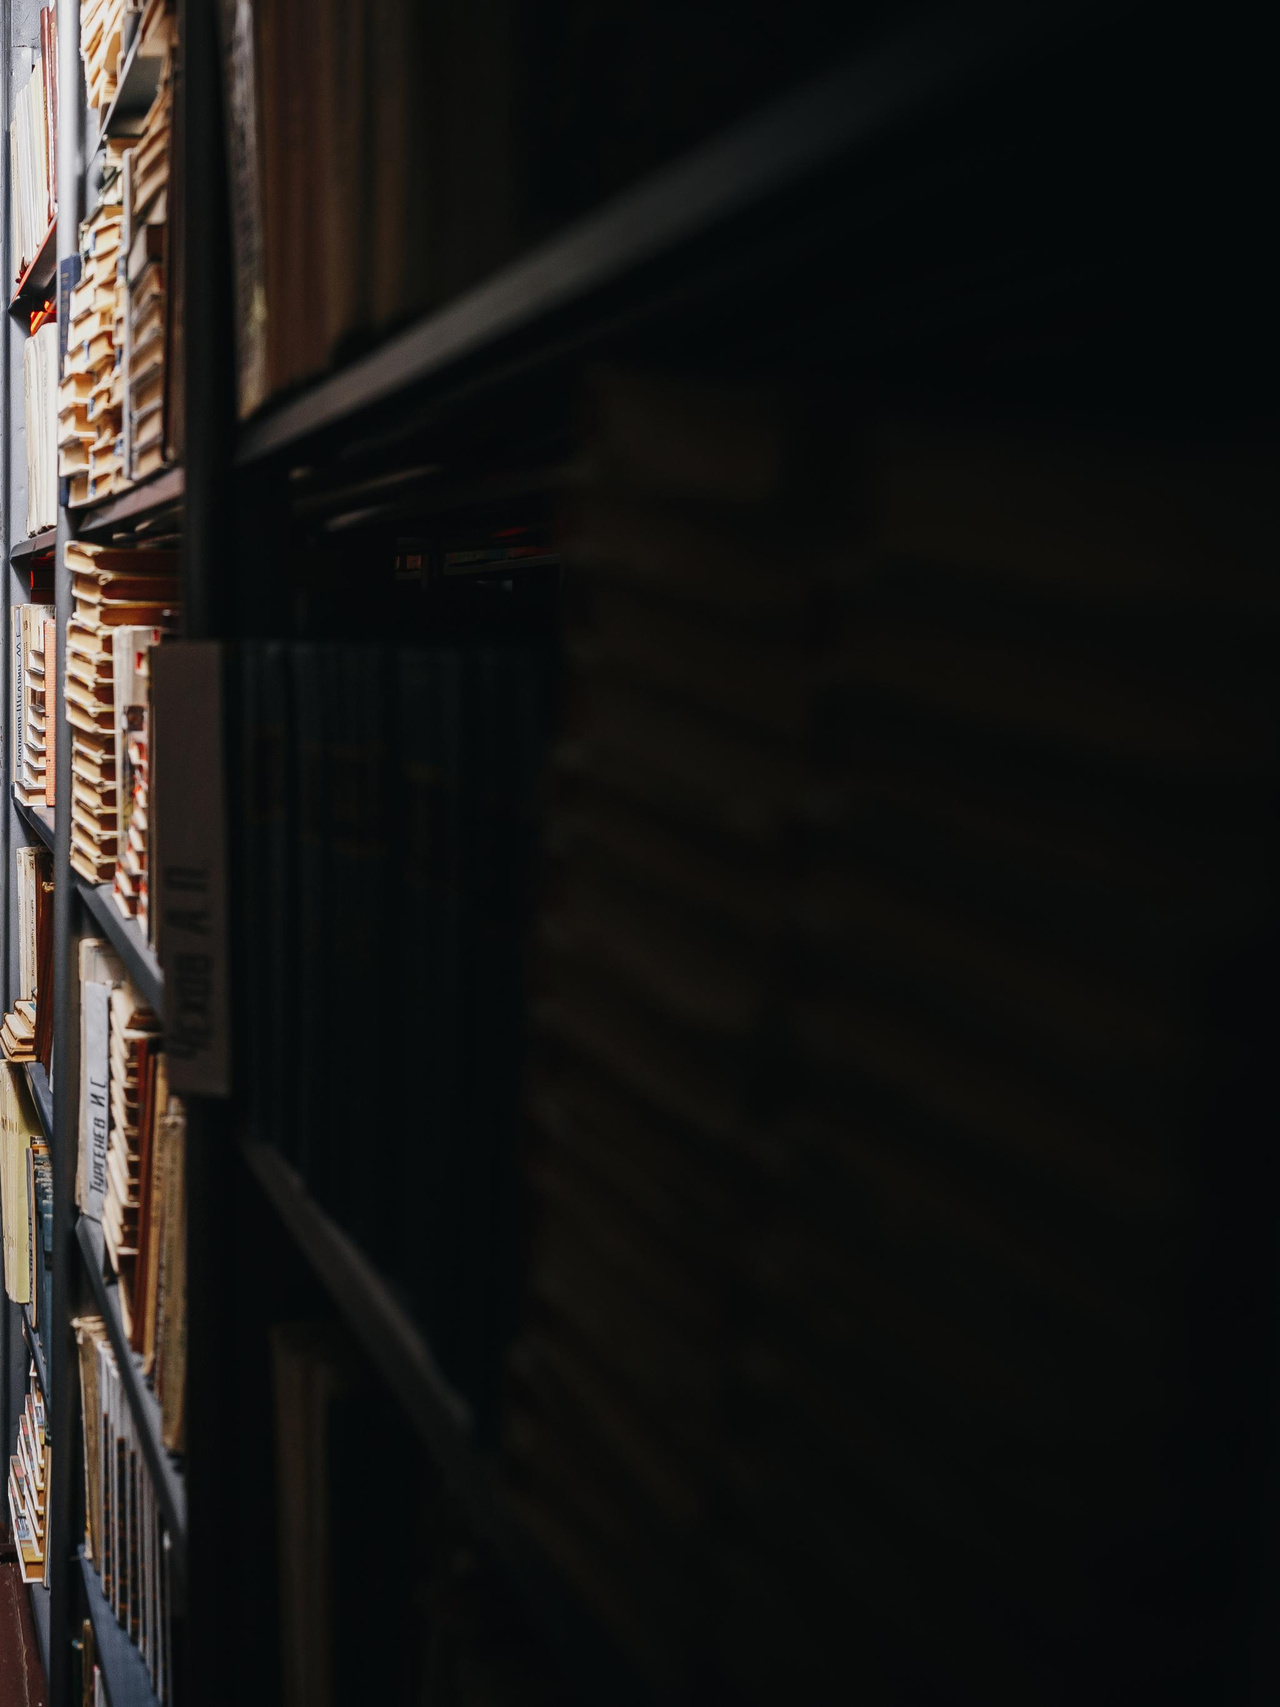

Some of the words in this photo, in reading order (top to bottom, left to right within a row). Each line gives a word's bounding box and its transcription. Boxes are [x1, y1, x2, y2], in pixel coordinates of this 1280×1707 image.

[165, 866, 210, 893] П
[166, 909, 211, 935] А
[90, 1092, 105, 1108] И
[89, 1117, 106, 1194] ТУРГЕНЕВ
